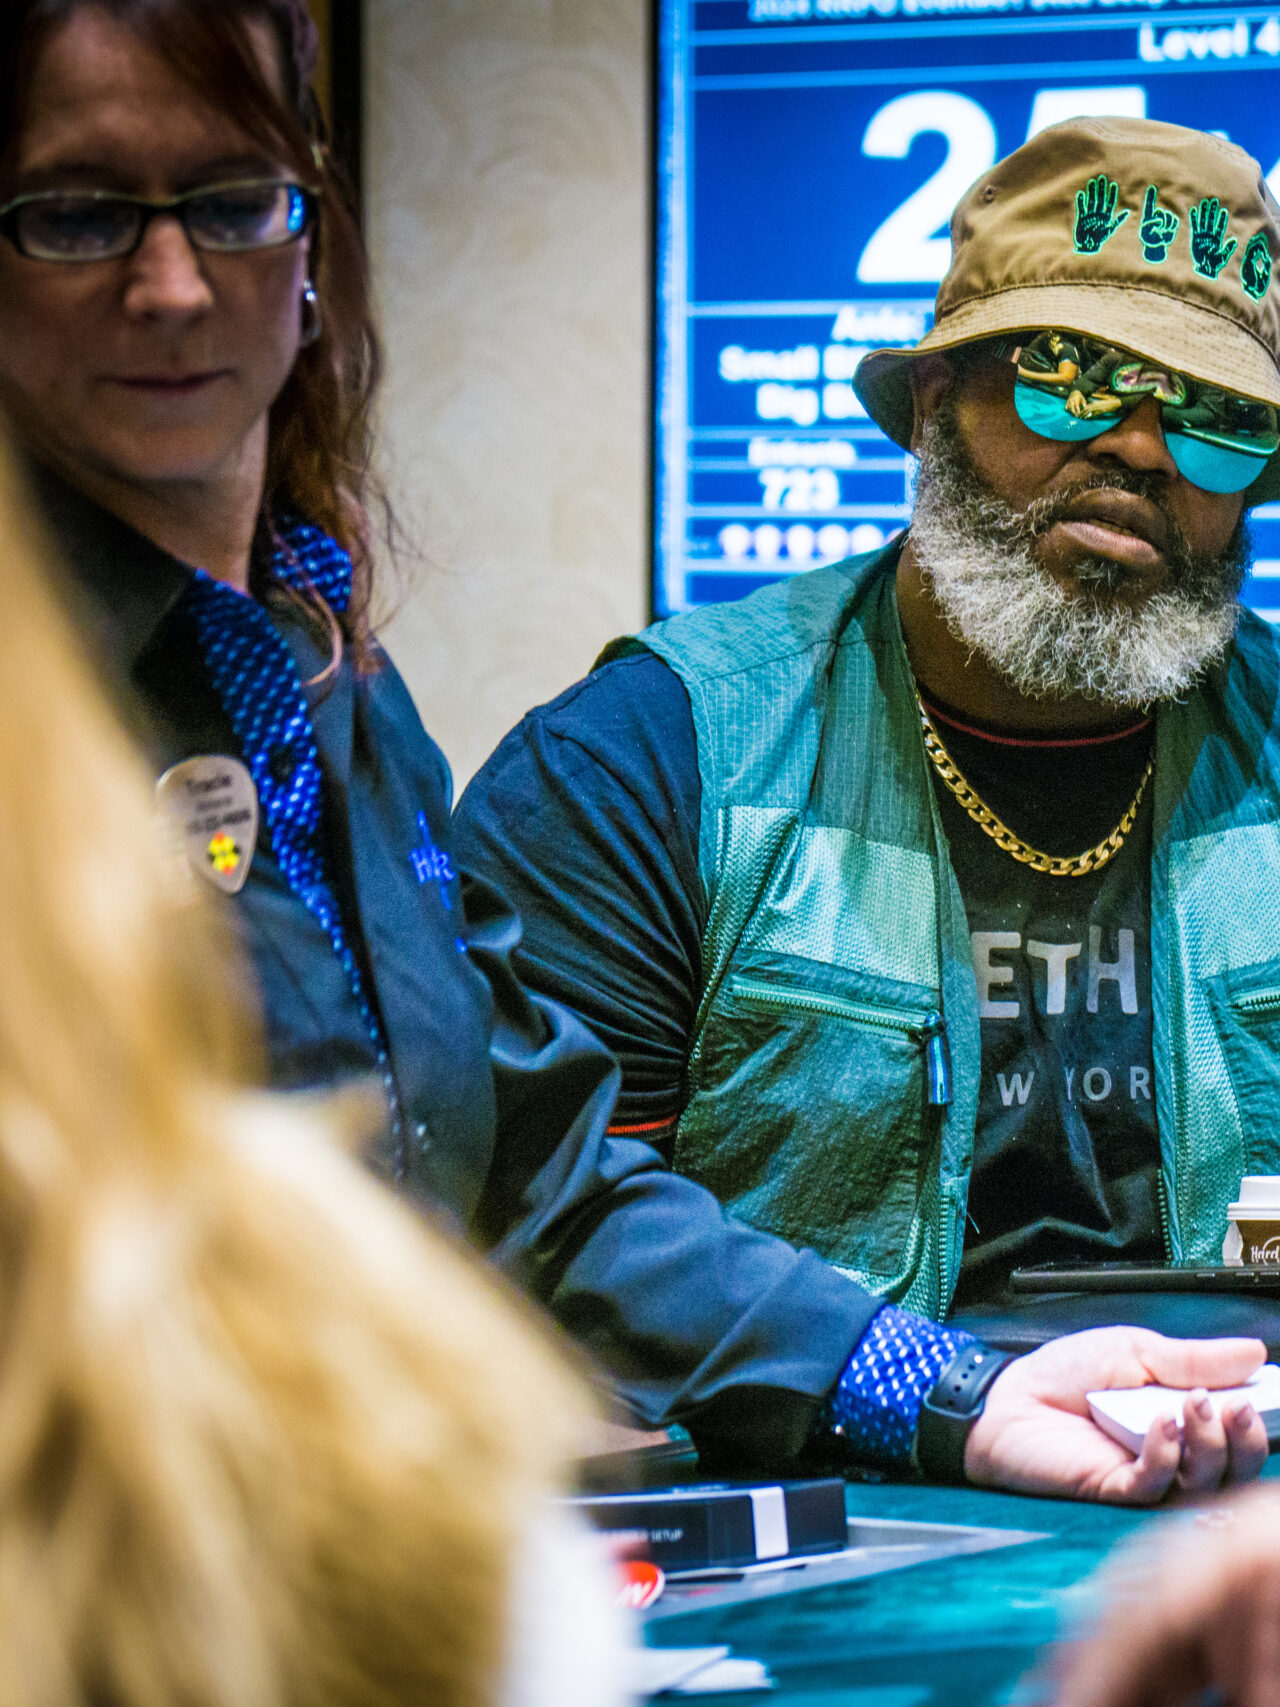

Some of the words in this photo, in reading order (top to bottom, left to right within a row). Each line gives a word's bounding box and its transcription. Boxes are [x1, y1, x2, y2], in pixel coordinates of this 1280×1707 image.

[1138, 21, 1249, 62] Level
[719, 345, 819, 382] Small
[755, 382, 819, 426] Big
[760, 467, 839, 511] 723
[971, 924, 1139, 1018] ETH
[1251, 1245, 1280, 1264] Hard
